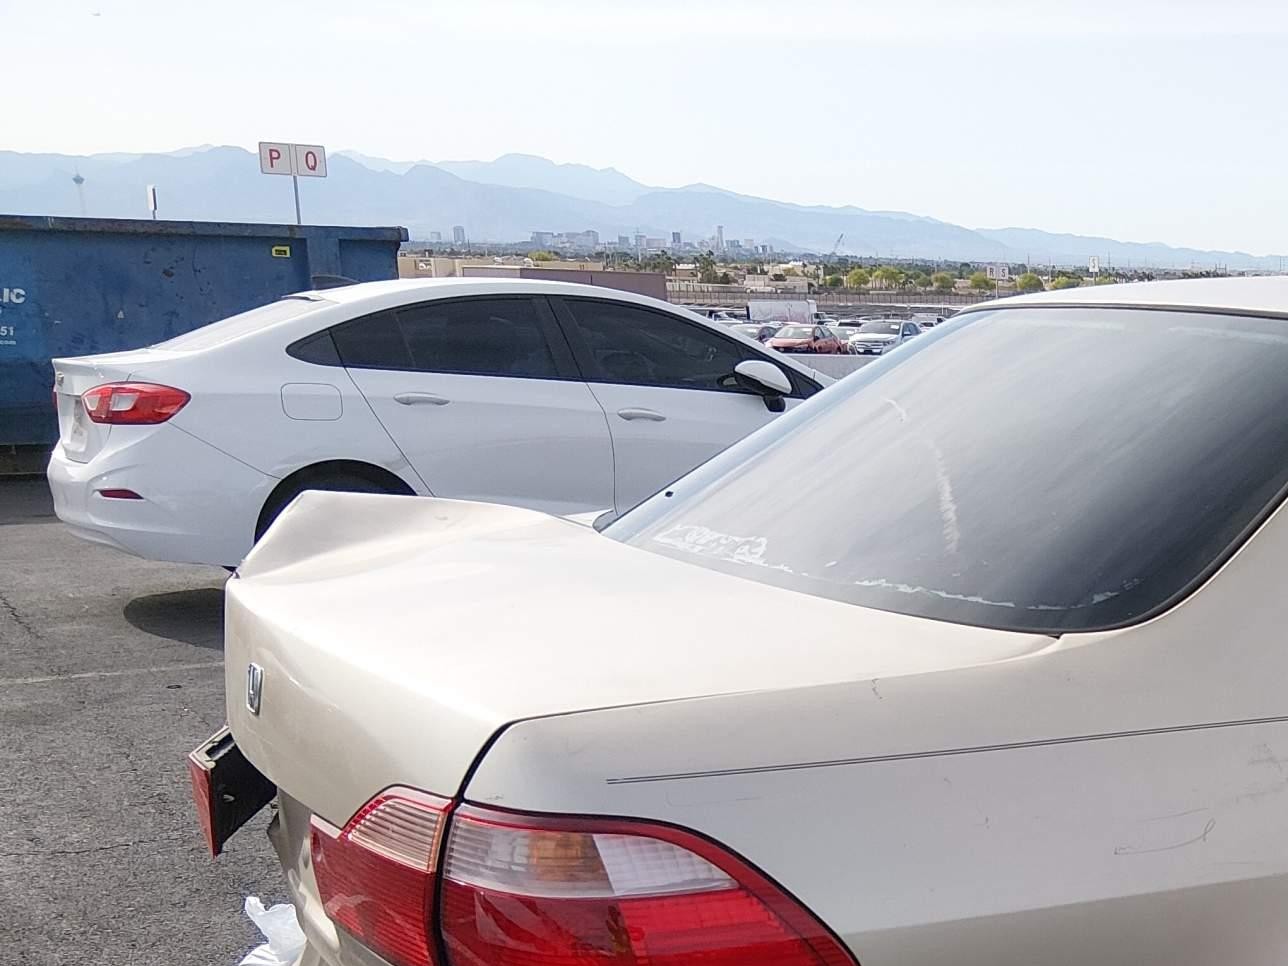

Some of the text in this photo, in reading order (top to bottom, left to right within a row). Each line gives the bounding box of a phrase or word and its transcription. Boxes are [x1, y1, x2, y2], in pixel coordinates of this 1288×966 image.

[268, 148, 281, 169] P
[305, 150, 317, 172] Q
[0, 287, 27, 305] IC
